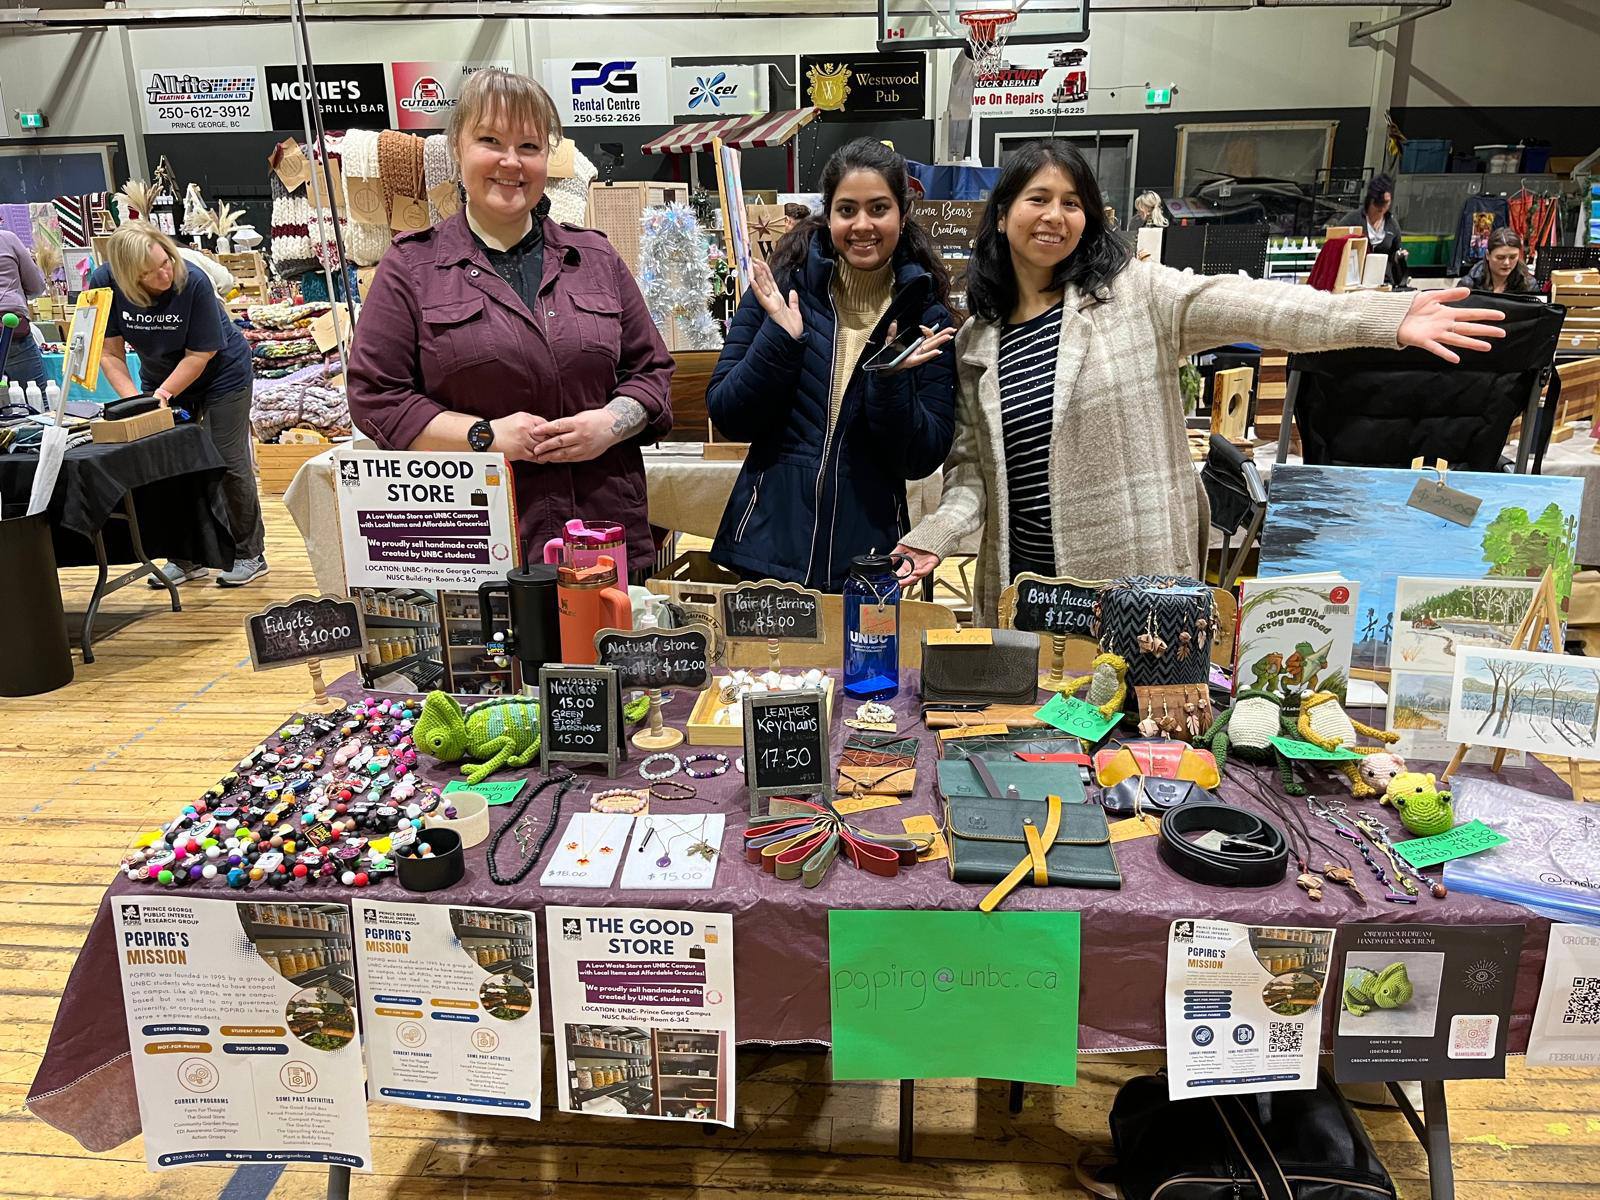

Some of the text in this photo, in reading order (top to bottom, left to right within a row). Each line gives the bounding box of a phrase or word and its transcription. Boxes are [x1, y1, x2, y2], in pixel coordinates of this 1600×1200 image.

[571, 61, 638, 94] PG
[856, 72, 919, 85] Westwood
[147, 74, 213, 97] Allrite
[271, 80, 361, 101] MOXIE'S
[876, 90, 900, 102] Pub
[989, 93, 1044, 106] On Repairs
[361, 104, 384, 112] BAR
[573, 98, 640, 111] Rental Centre
[158, 105, 250, 119] 250-612-3912
[574, 114, 641, 122] 250-562-2626
[931, 221, 968, 237] Creations
[363, 459, 474, 479] THE GOOD
[387, 484, 455, 503] STORE
[453, 512, 479, 520] Campus
[382, 540, 410, 549] proudly
[425, 541, 465, 549] handmade
[411, 550, 420, 558] by
[444, 551, 476, 559] students
[446, 568, 470, 576] George
[1028, 588, 1098, 608] Bark Accesso
[1336, 591, 1343, 599] 2
[761, 594, 773, 615] of
[776, 596, 815, 616] Earrings
[1266, 608, 1296, 619] Days
[265, 611, 313, 638] Fidgets
[1256, 616, 1332, 635] Frog and Toad
[850, 631, 888, 644] UNBC
[607, 637, 658, 654] Natural
[559, 697, 594, 709] 15.00
[765, 706, 811, 718] LEATHER
[558, 734, 594, 744] 15.00
[761, 747, 811, 769] 17.50
[586, 918, 694, 936] THE GOOD
[124, 931, 189, 947] PGPIRG'S
[365, 928, 411, 941] PGPIRG'S
[366, 941, 409, 954] MISSION
[609, 938, 674, 955] STORE
[1187, 947, 1226, 959] PGPIRG'S
[127, 950, 187, 965] MISSION
[1187, 959, 1224, 969] MISSION
[600, 985, 628, 994] proudly
[834, 963, 1057, 1011] pgpirg@unbc.ca
[627, 994, 637, 1002] by
